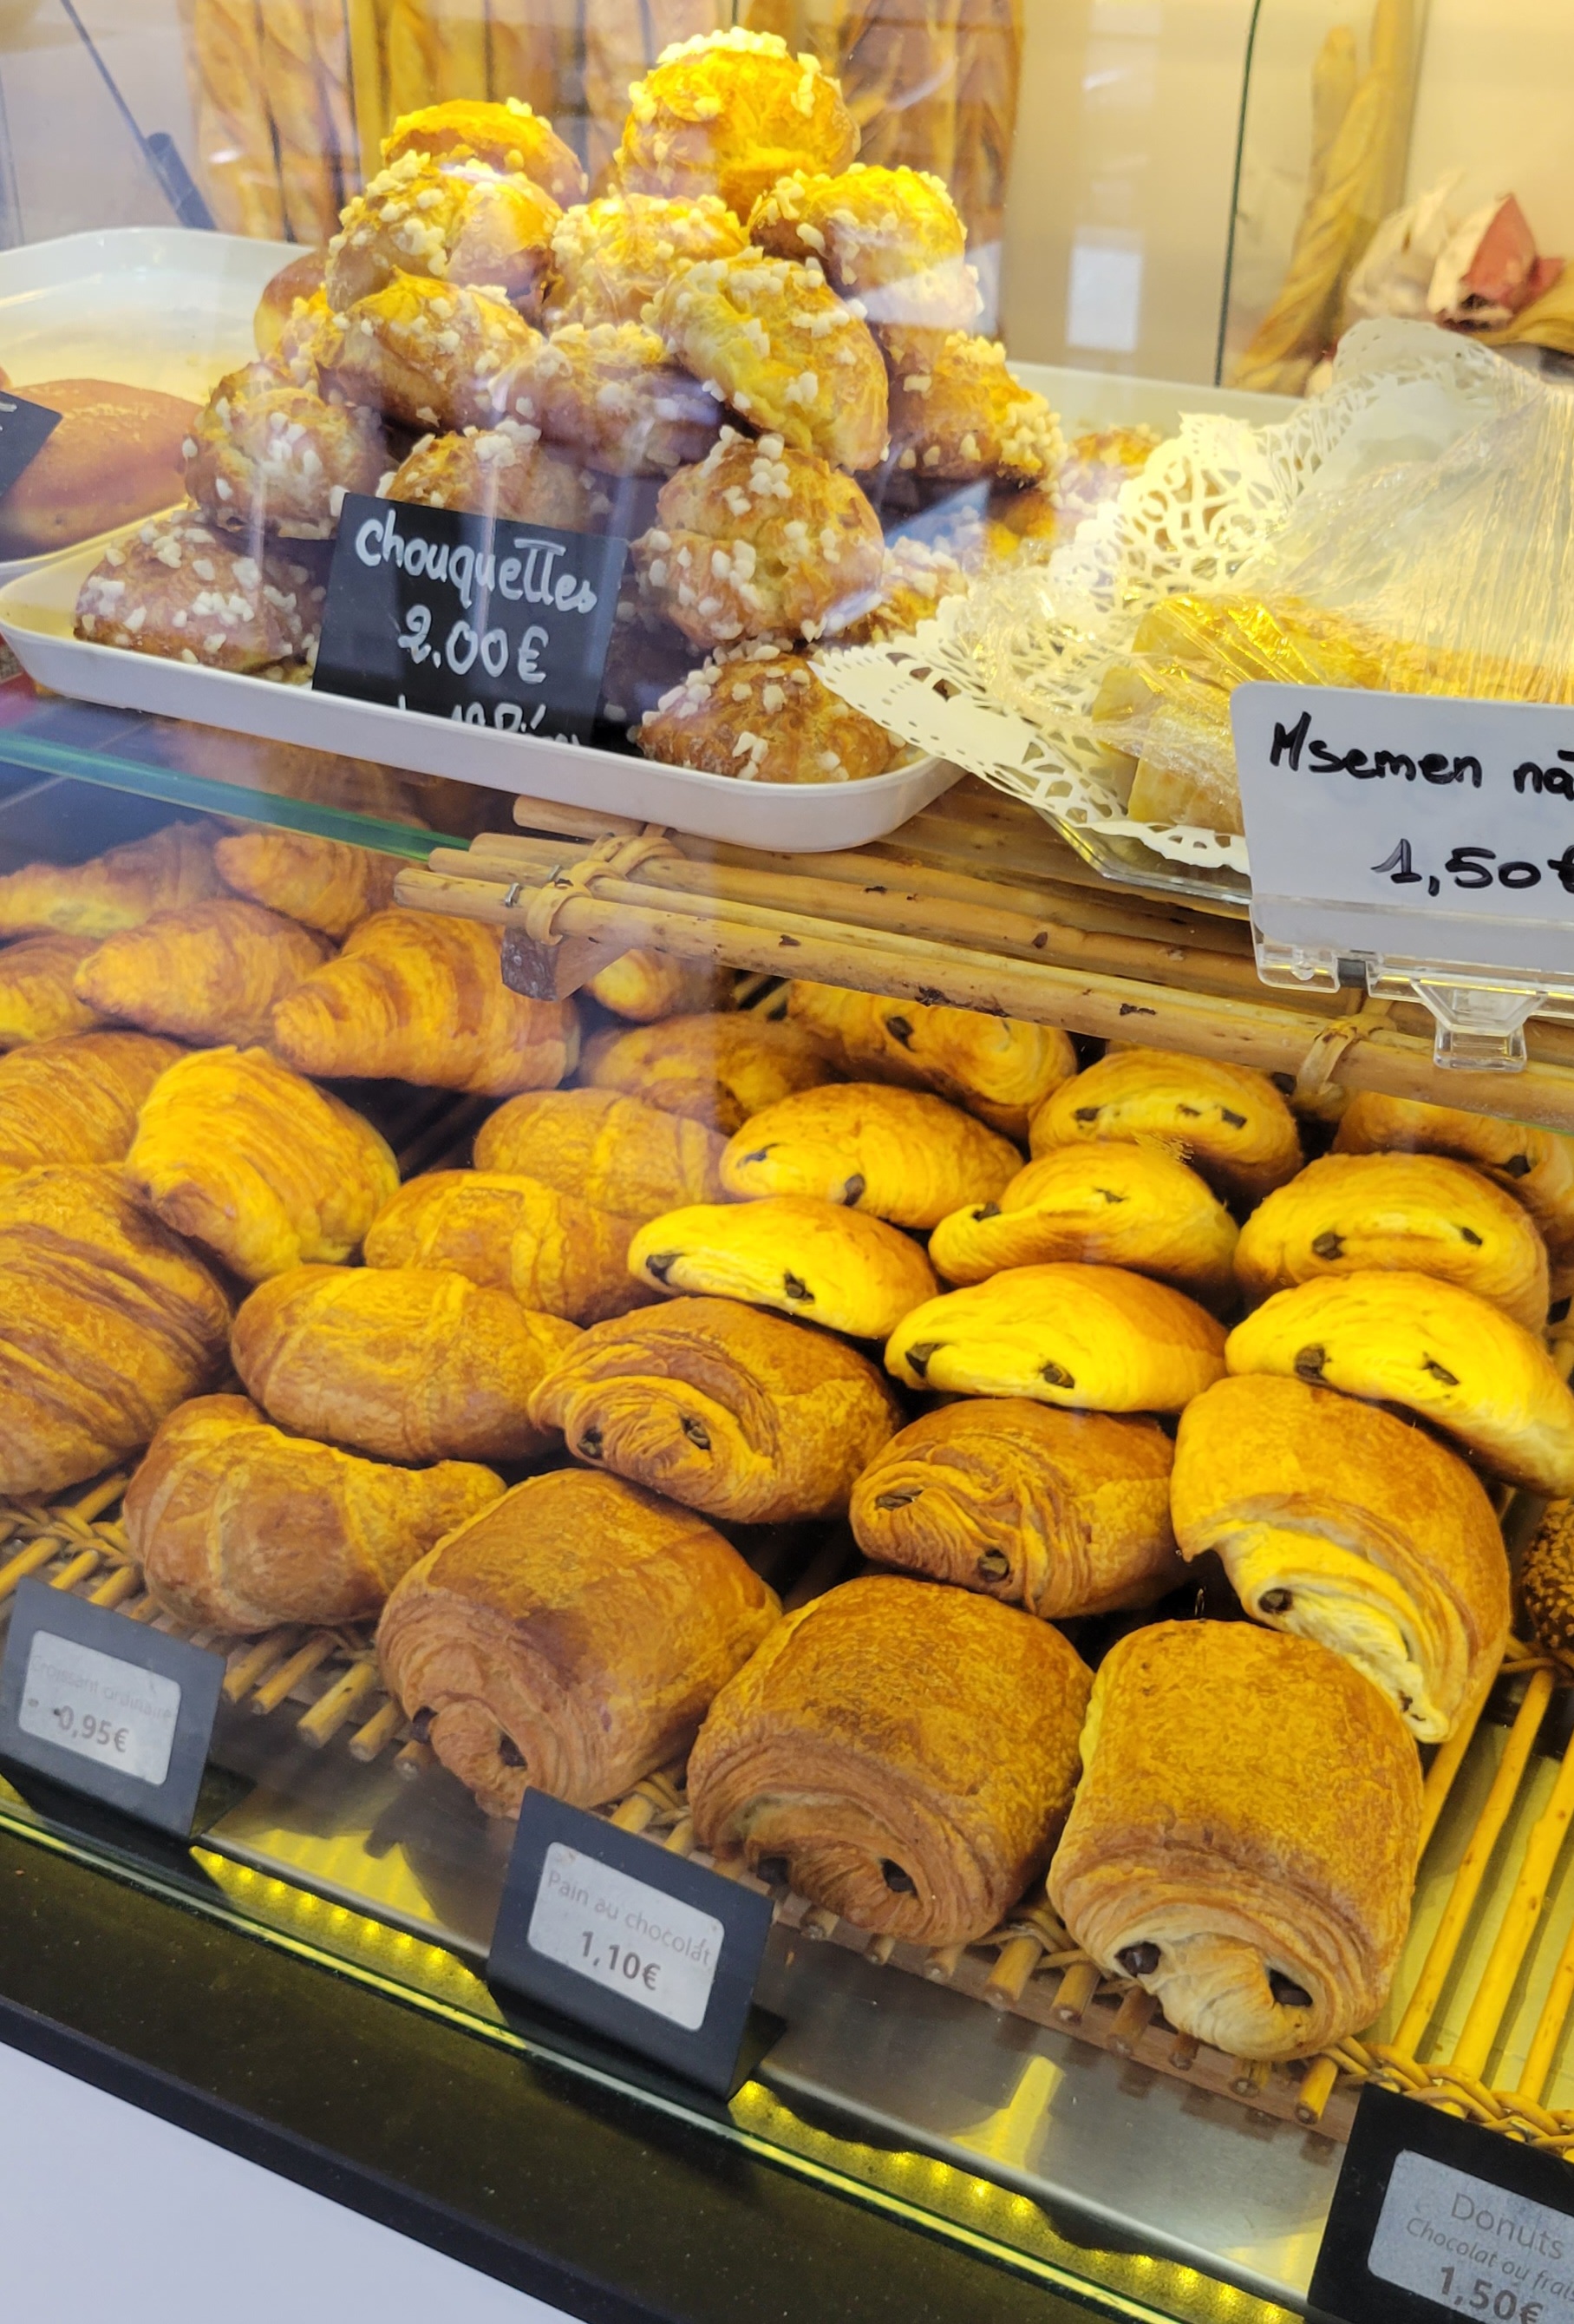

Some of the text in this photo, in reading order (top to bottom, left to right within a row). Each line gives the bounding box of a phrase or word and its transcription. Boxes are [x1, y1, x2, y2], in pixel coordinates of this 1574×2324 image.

[1270, 711, 1574, 801] Msemen na
[546, 1869, 712, 1967] Pain au chocolat
[581, 1930, 662, 1990] 1,10€
[1406, 2217, 1499, 2268] Chocolat
[1502, 2260, 1530, 2281] ou
[1451, 2192, 1564, 2260] Donuts
